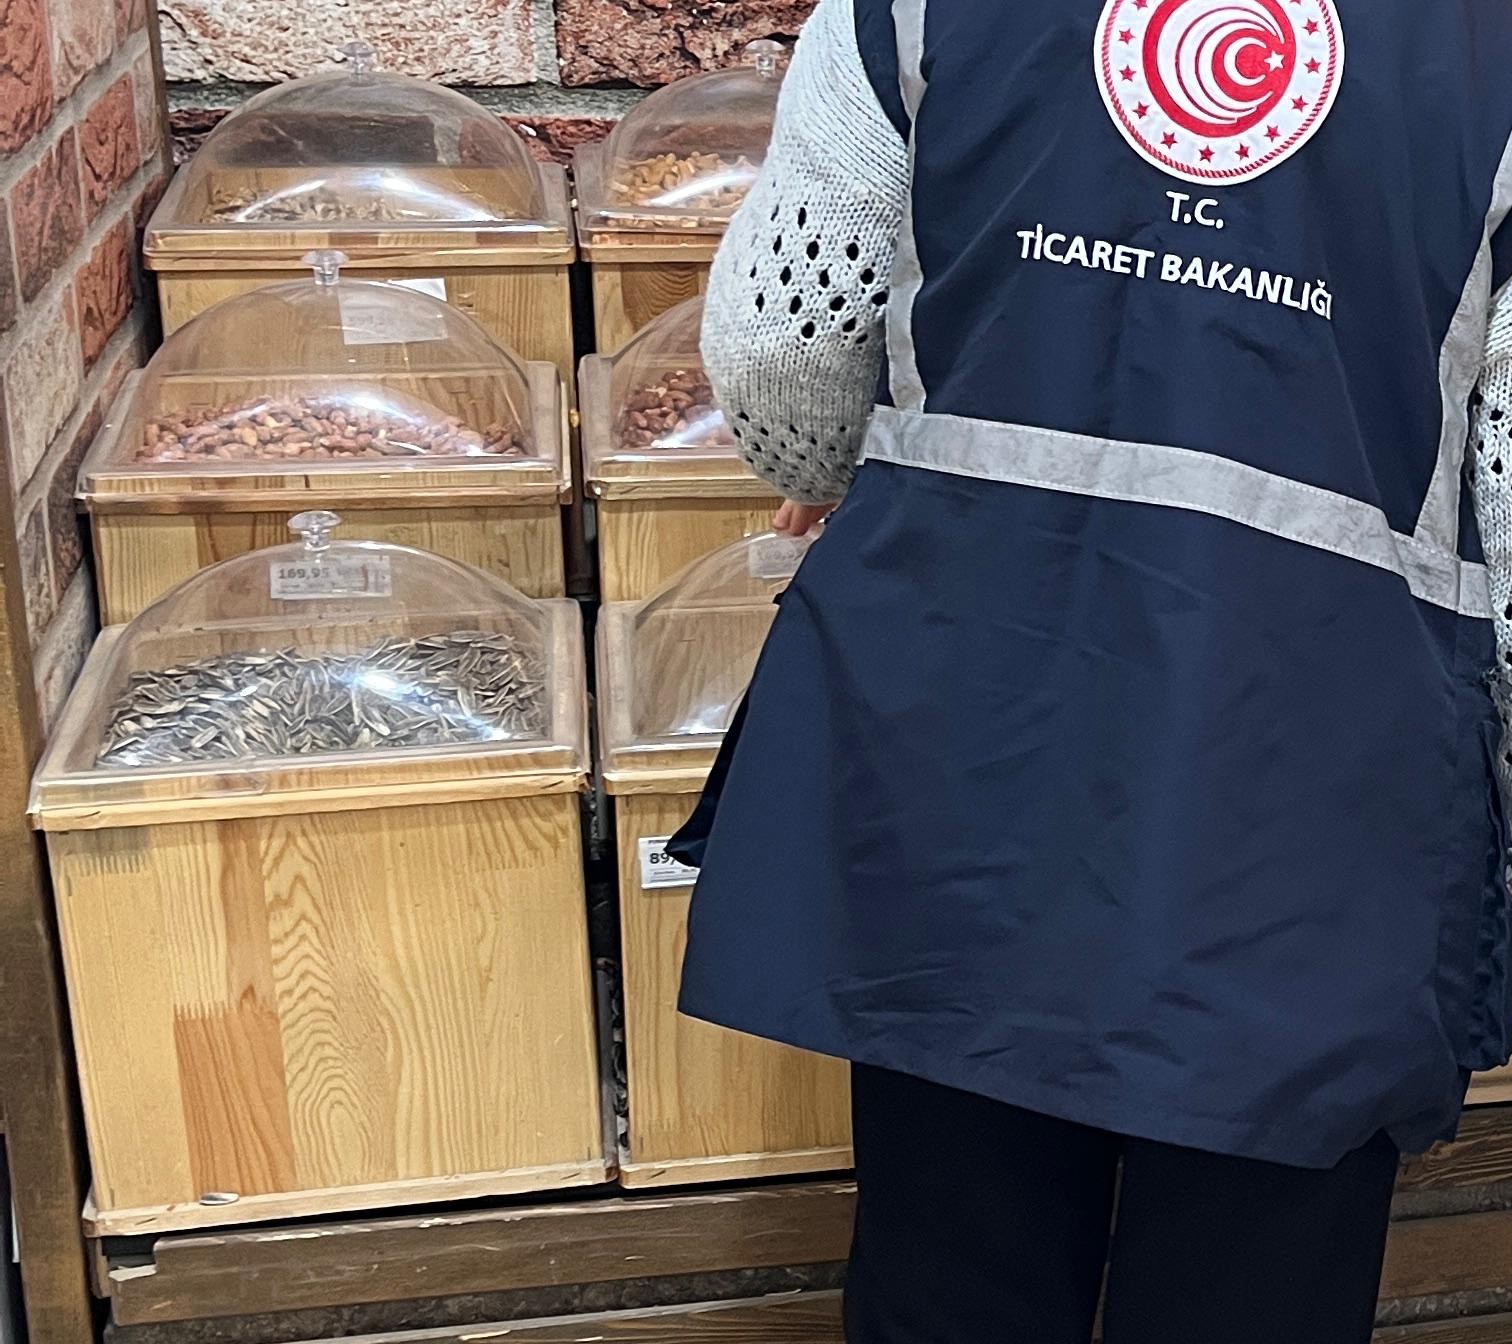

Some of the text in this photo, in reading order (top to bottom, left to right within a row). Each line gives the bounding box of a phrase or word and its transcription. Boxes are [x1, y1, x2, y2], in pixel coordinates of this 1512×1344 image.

[1165, 190, 1224, 230] T.C.
[1016, 223, 1332, 320] TİCARET BAKANLIĞI
[649, 852, 676, 866] 89,
